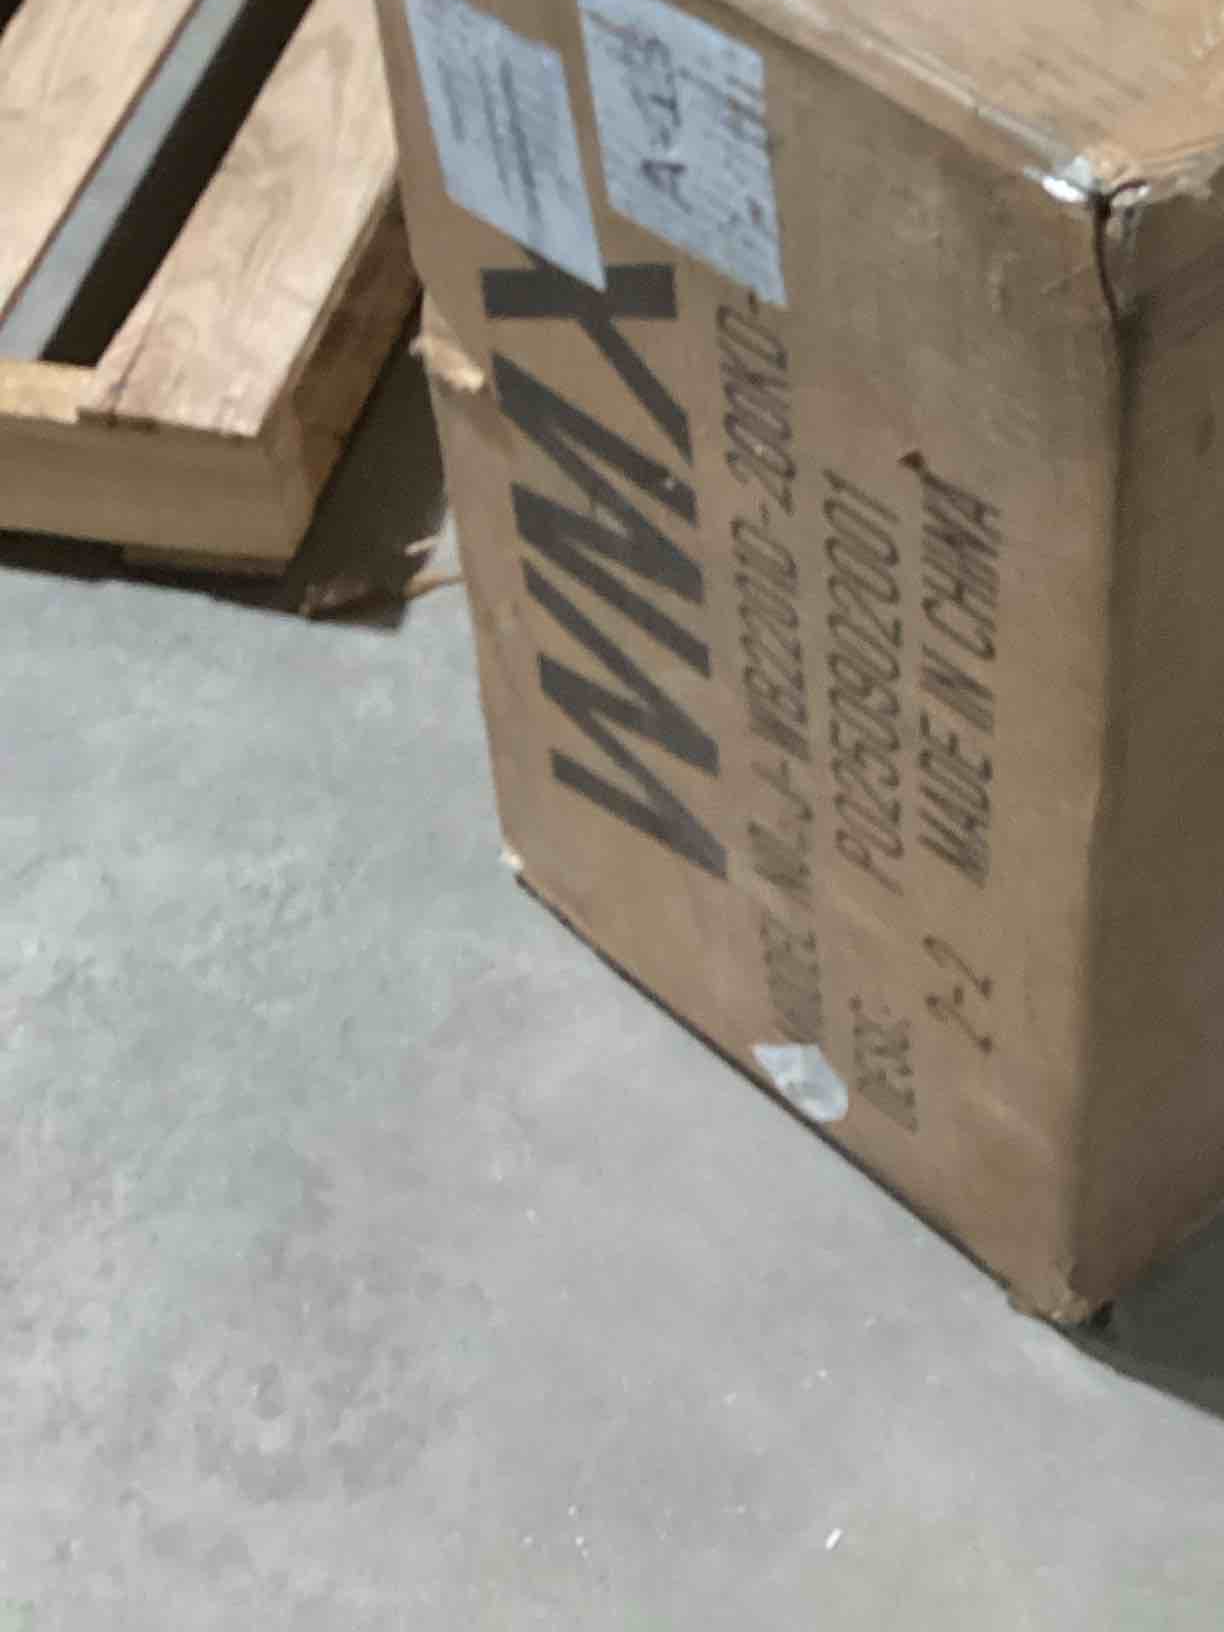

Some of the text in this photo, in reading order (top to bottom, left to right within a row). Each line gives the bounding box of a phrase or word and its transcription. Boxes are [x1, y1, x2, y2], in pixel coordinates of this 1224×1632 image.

[481, 263, 727, 880] WMX
[916, 466, 1002, 890] MADE IN CHINA
[924, 935, 994, 1054] 2-2
